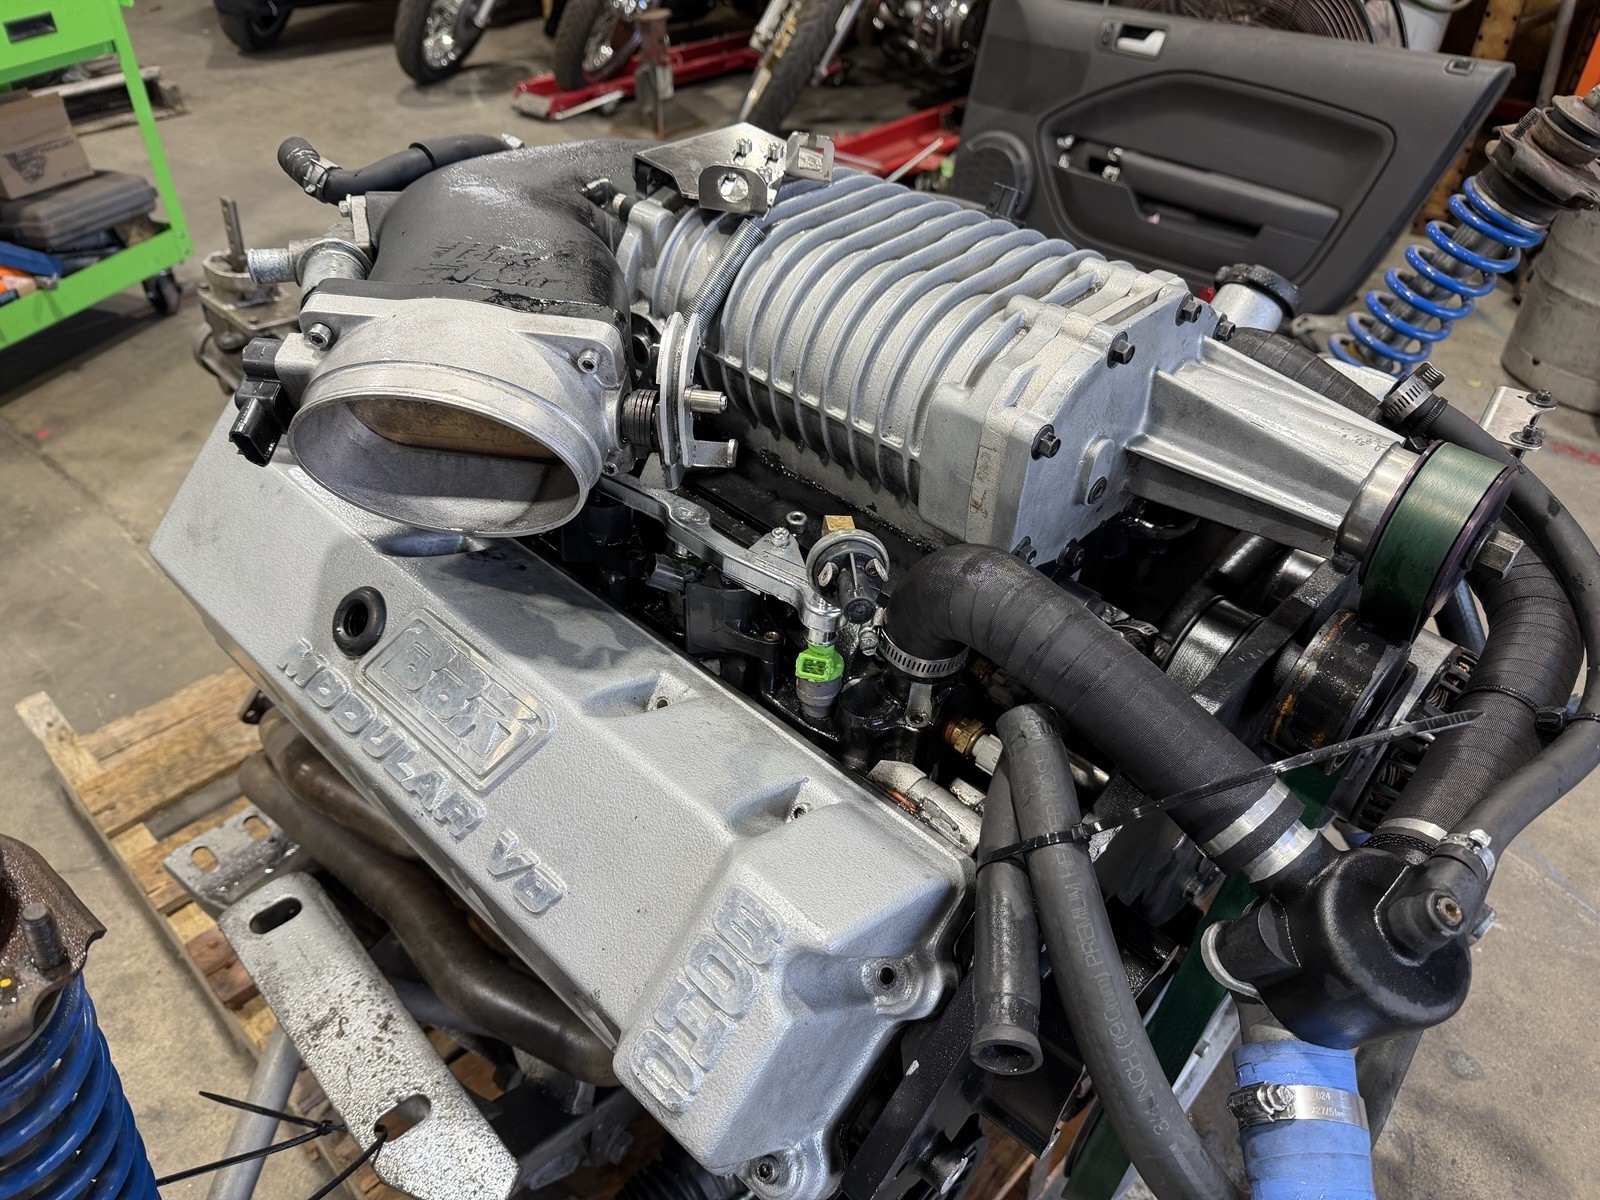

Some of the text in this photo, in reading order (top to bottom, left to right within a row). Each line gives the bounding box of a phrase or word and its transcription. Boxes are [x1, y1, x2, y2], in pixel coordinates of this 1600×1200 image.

[277, 638, 567, 912] MODULAR V8
[1046, 803, 1074, 880] HEER
[1065, 881, 1101, 968] PREMIUM
[1121, 1054, 1153, 1102] INCH
